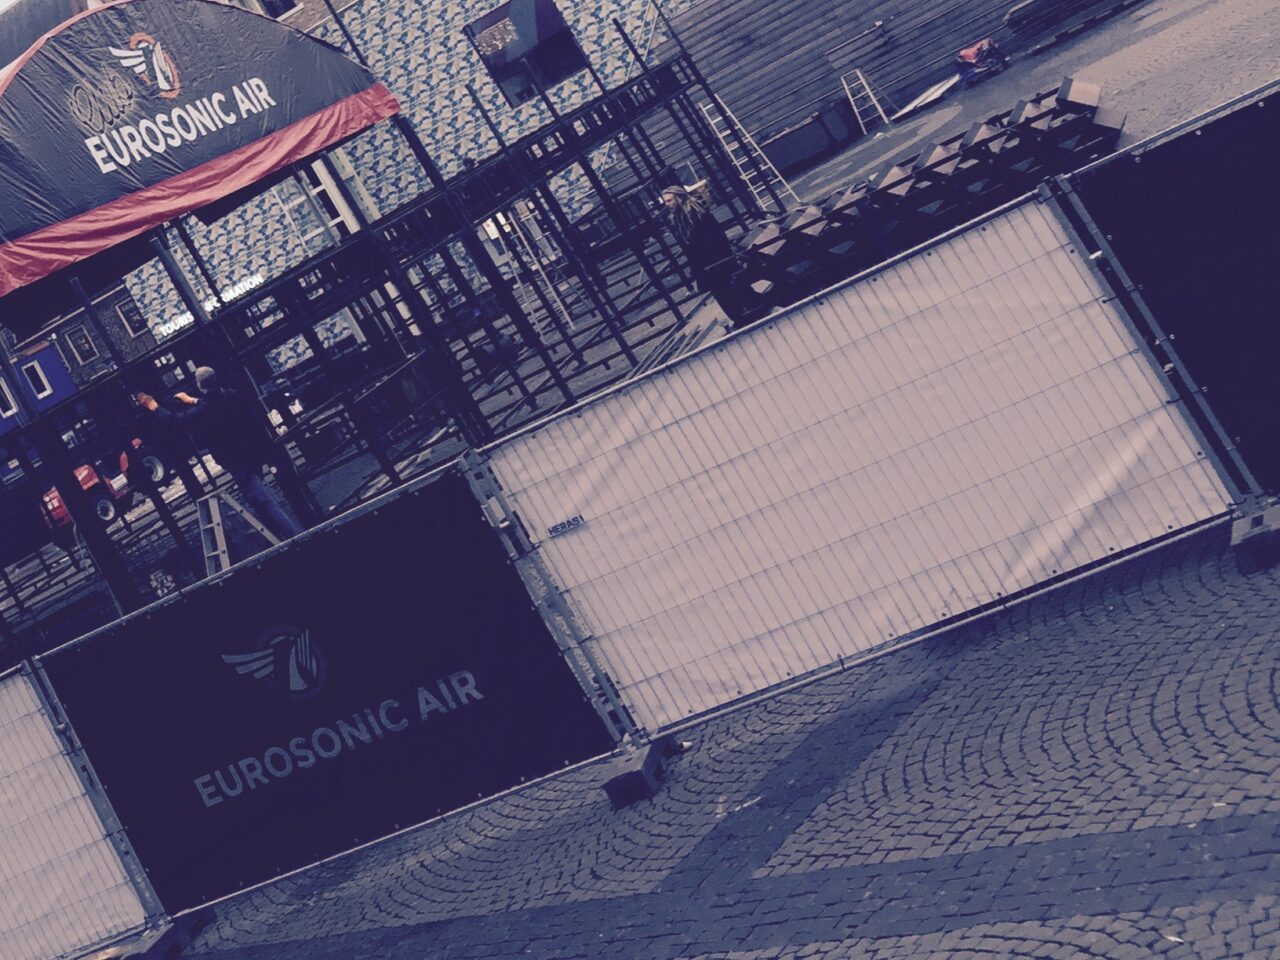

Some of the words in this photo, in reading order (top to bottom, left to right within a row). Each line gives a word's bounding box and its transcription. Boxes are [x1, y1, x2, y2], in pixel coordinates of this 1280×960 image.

[84, 92, 237, 174] EUROSONIC
[232, 77, 277, 119] AIR
[160, 310, 195, 337] TOURIS
[547, 515, 581, 536] HERAS
[193, 698, 409, 808] EUROSONIC
[417, 669, 485, 721] AIR
